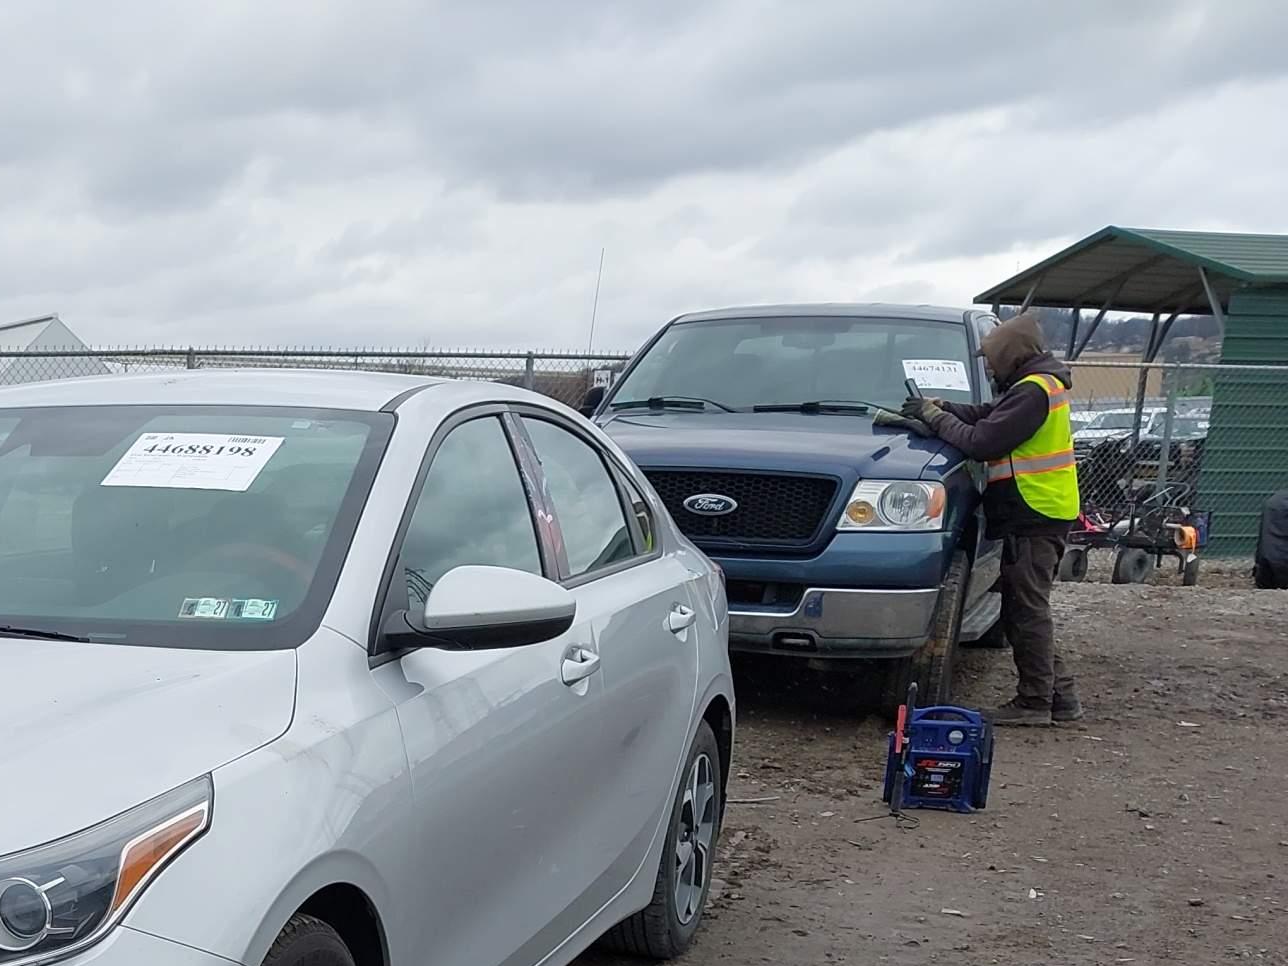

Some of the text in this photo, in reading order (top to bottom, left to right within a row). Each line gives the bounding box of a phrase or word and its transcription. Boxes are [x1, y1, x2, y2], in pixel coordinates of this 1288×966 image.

[143, 443, 257, 457] 44688198
[694, 497, 726, 511] Ford
[213, 600, 227, 616] 27
[261, 602, 275, 617] 27
